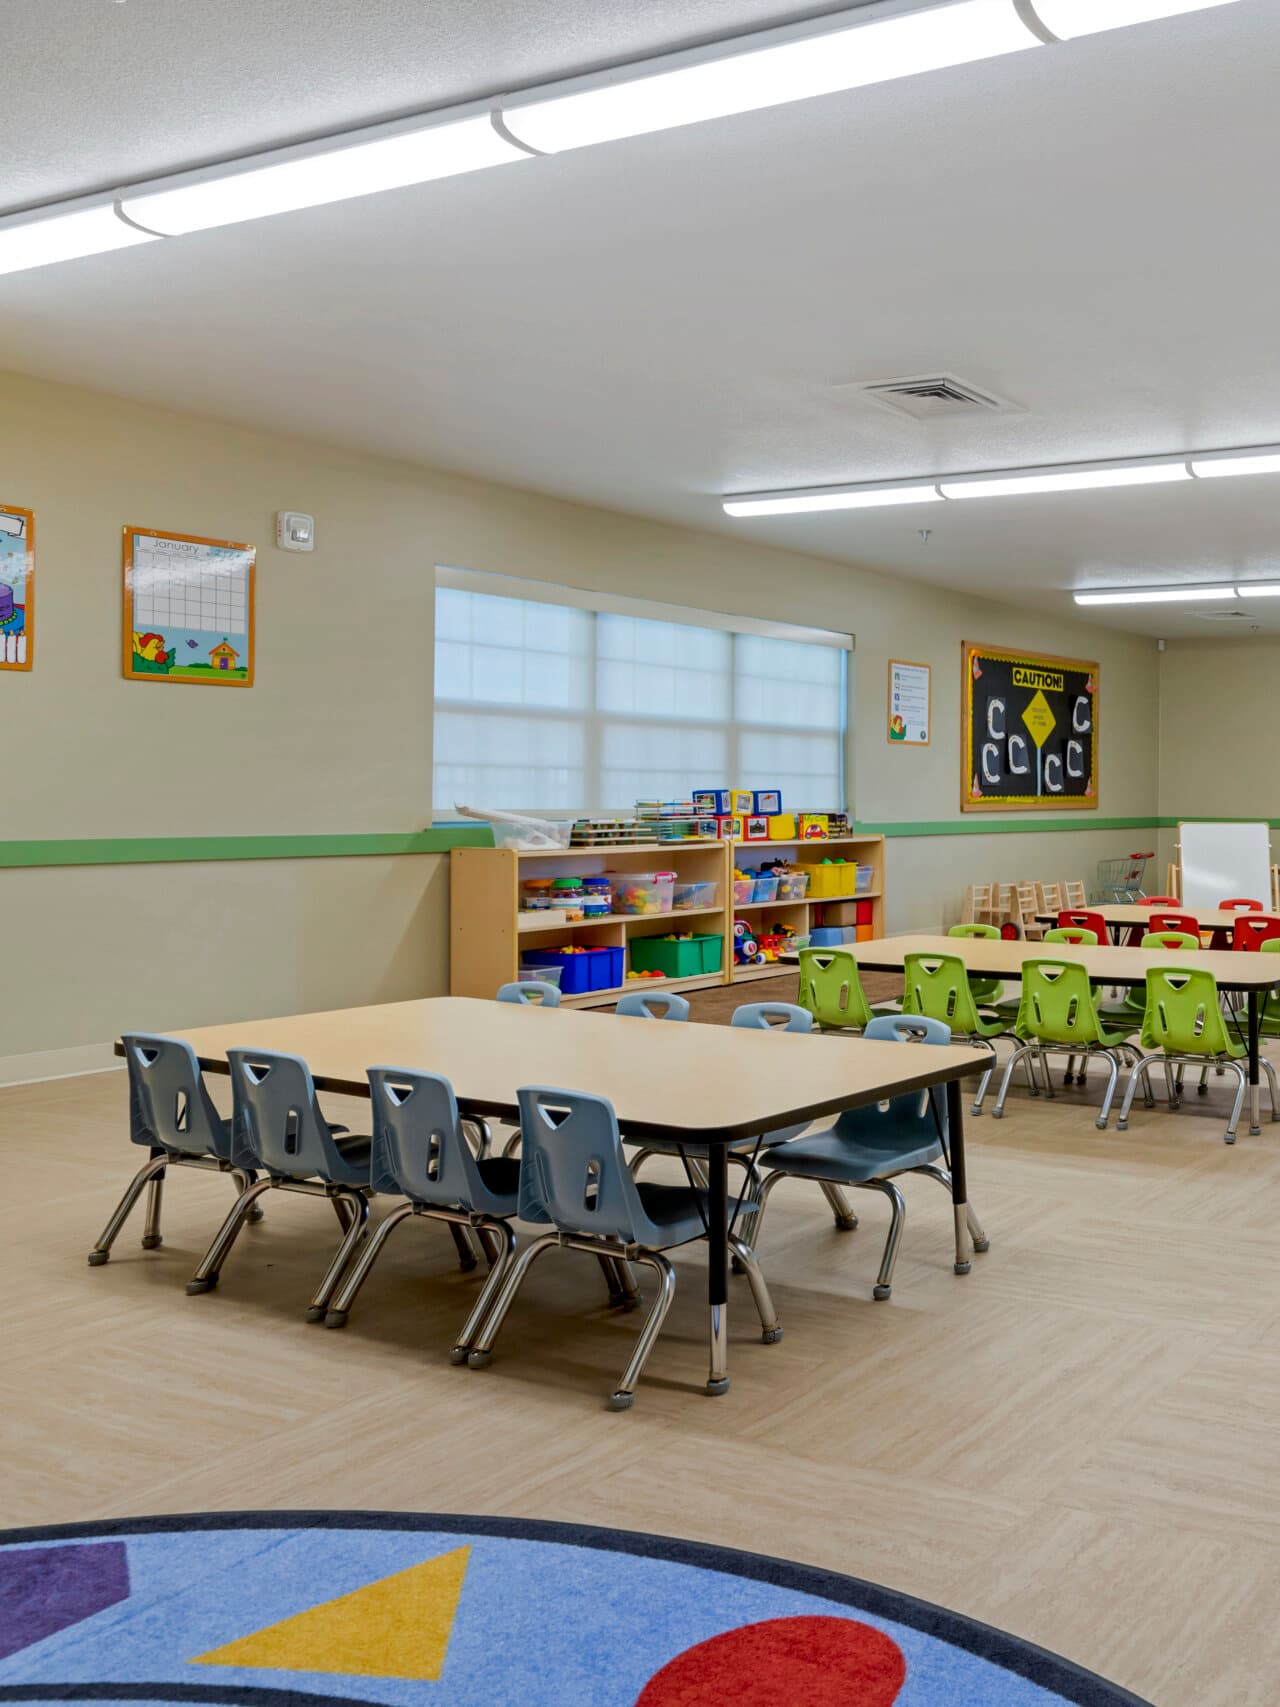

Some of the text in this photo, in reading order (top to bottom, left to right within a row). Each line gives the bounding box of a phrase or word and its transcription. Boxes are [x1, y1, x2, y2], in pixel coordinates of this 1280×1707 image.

[152, 539, 199, 555] January
[1014, 670, 1062, 689] CAUTION!
[988, 699, 1005, 740] C
[1072, 696, 1090, 732] C
[982, 743, 1000, 783] C
[1008, 735, 1027, 774] C
[1045, 753, 1062, 791] C
[1066, 740, 1082, 777] C
